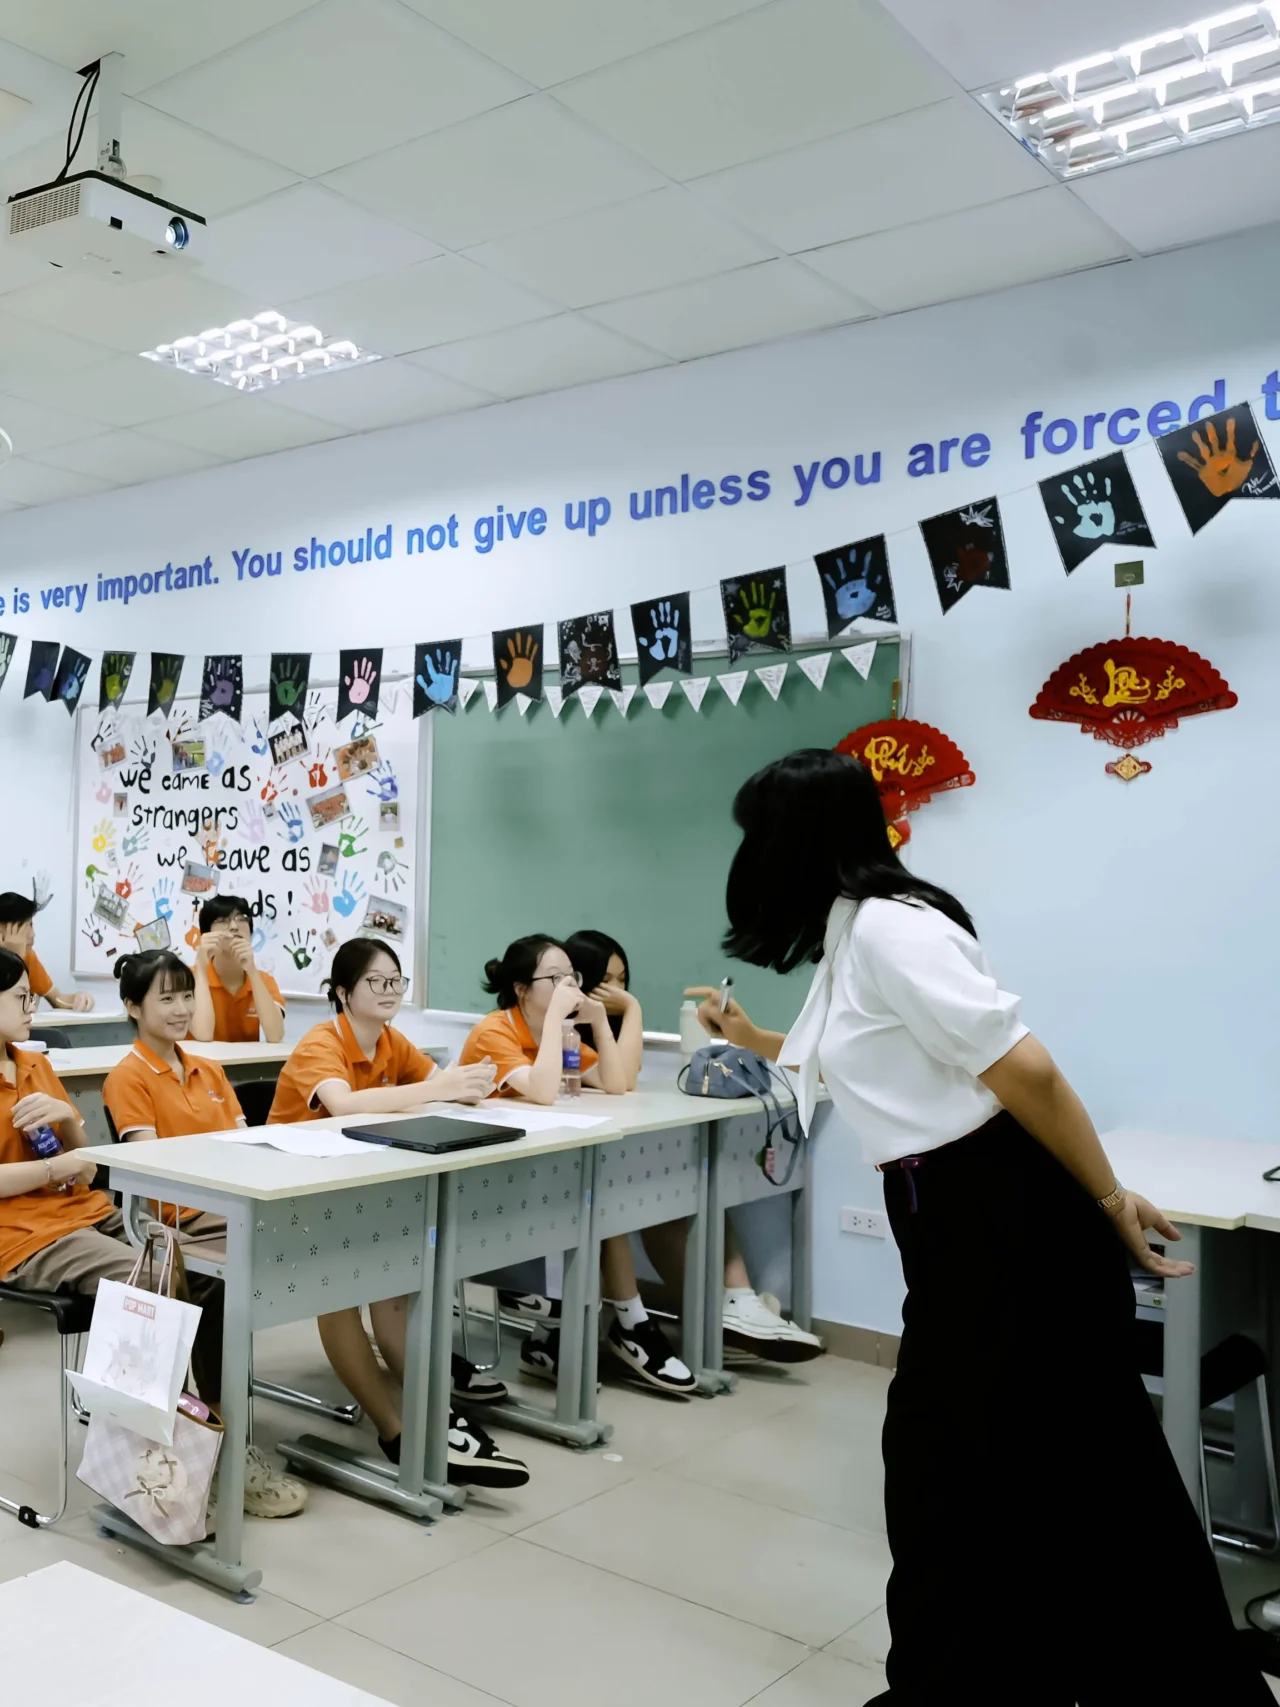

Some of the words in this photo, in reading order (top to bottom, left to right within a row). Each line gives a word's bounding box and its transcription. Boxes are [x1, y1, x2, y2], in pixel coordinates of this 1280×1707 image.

[13, 587, 30, 614] is
[40, 583, 89, 614] very
[97, 555, 219, 605] important.
[231, 548, 283, 581] You
[293, 524, 393, 572] should
[406, 514, 459, 555] not
[473, 504, 548, 554] give
[564, 495, 611, 537] up
[629, 470, 772, 521] unless
[794, 451, 882, 507] you
[907, 432, 992, 478] are
[1020, 378, 1228, 460] forced
[119, 768, 152, 794] we
[222, 764, 251, 792] as
[131, 803, 239, 837] strangers
[157, 845, 188, 870] we
[281, 846, 311, 873] as
